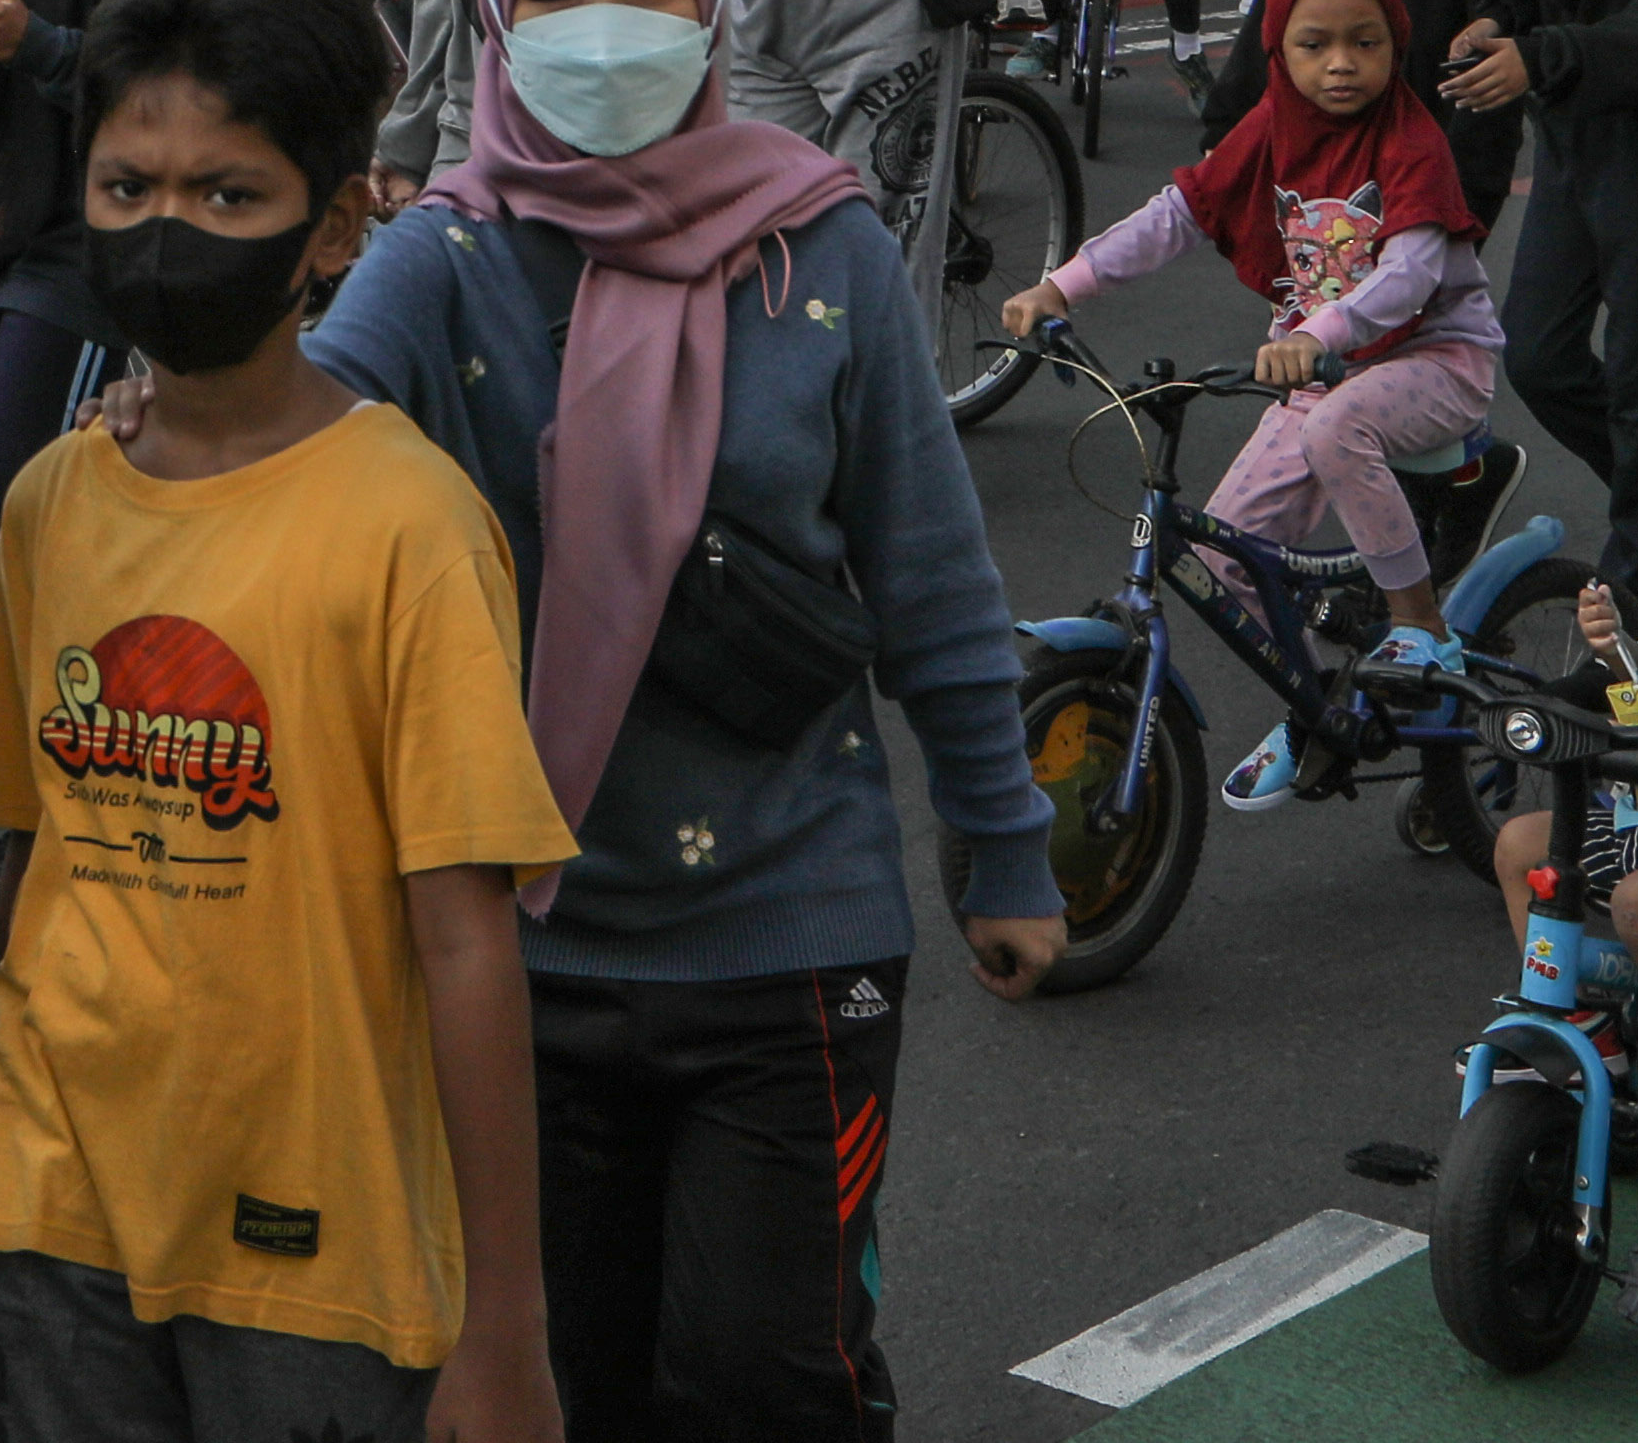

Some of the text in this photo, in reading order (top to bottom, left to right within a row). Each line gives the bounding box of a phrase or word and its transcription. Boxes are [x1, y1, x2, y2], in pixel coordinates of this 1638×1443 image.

[40, 646, 280, 831] Sunny
[1138, 696, 1160, 768] UNITED
[194, 883, 246, 900] Heart
